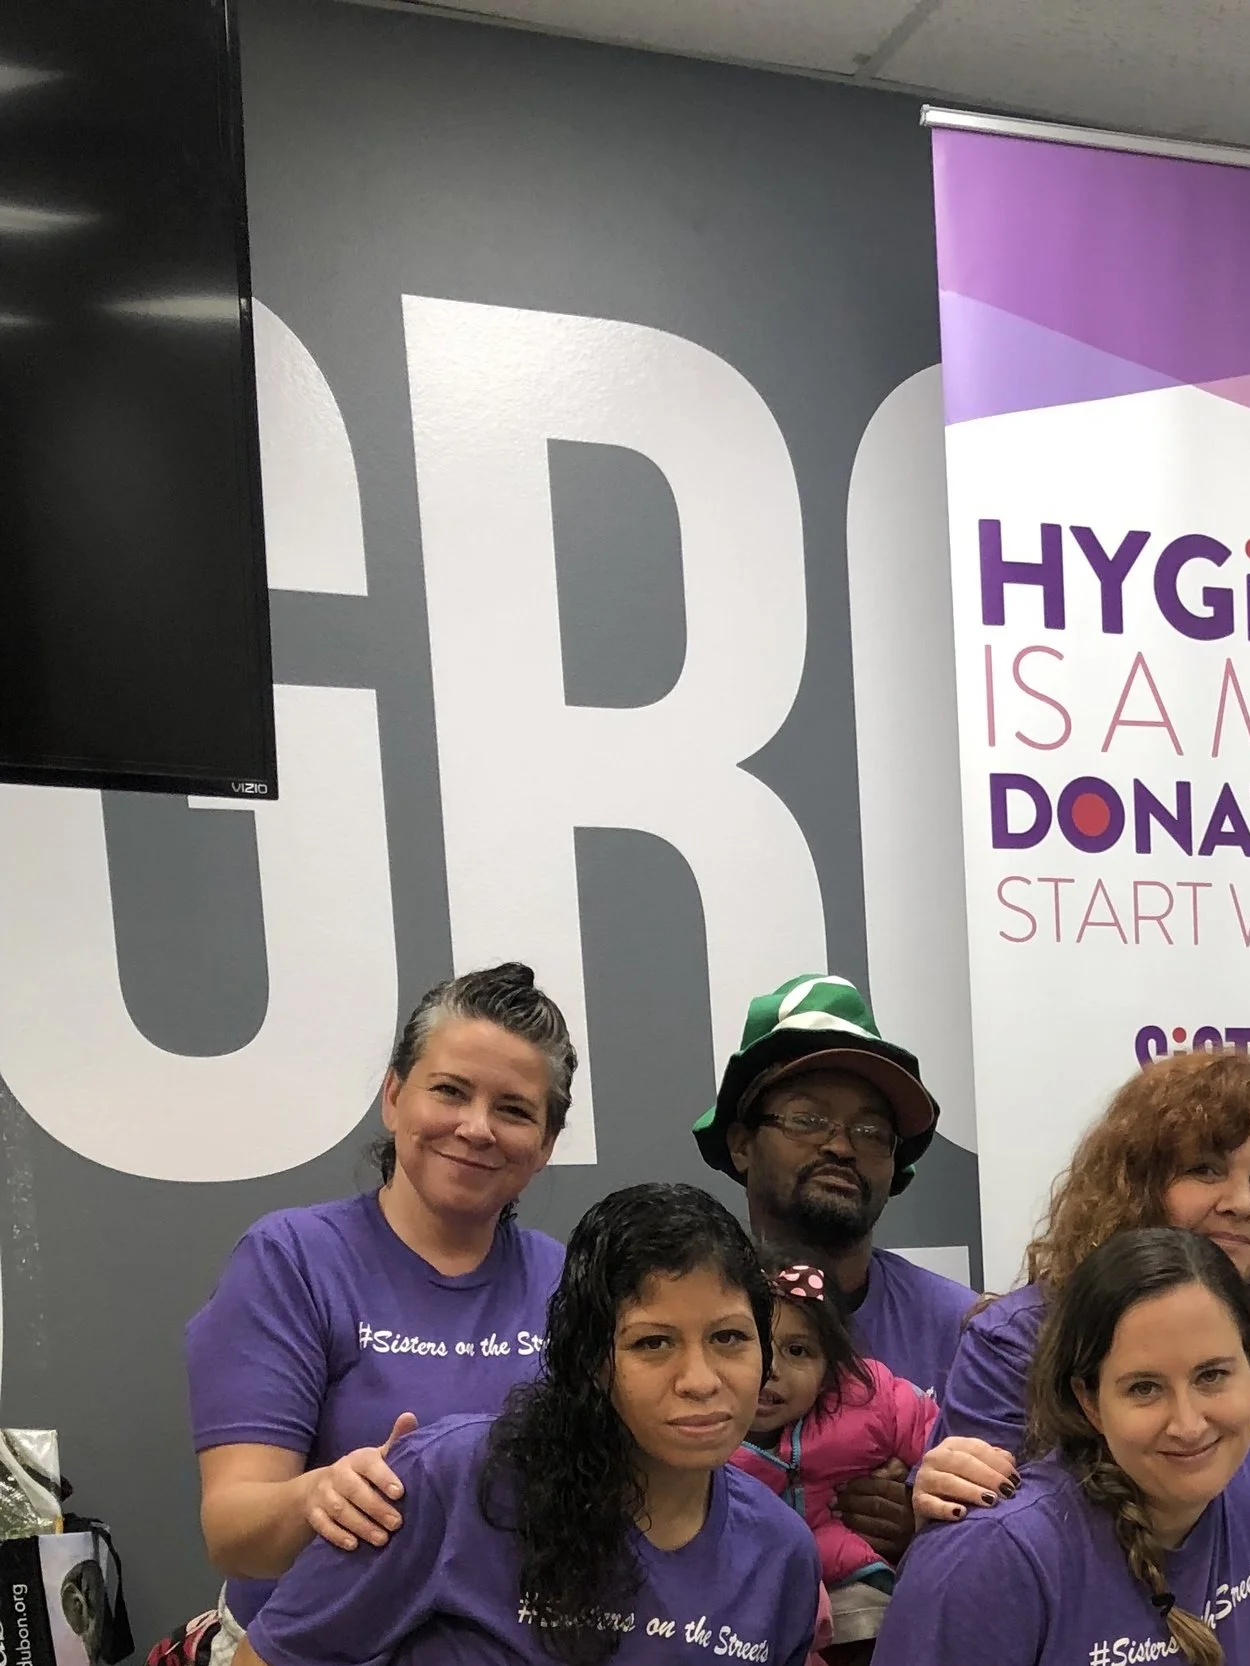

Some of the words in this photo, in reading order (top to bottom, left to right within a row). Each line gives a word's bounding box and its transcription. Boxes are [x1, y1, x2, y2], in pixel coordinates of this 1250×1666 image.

[984, 644, 1072, 751] IS
[1101, 651, 1183, 756] A
[231, 781, 268, 794] VIZIO
[997, 876, 1212, 946] START
[358, 1321, 449, 1357] #Sisters
[455, 1341, 475, 1357] on
[480, 1332, 511, 1357] the
[645, 1616, 676, 1638] on
[684, 1615, 713, 1647] the
[713, 1625, 770, 1663] Streets
